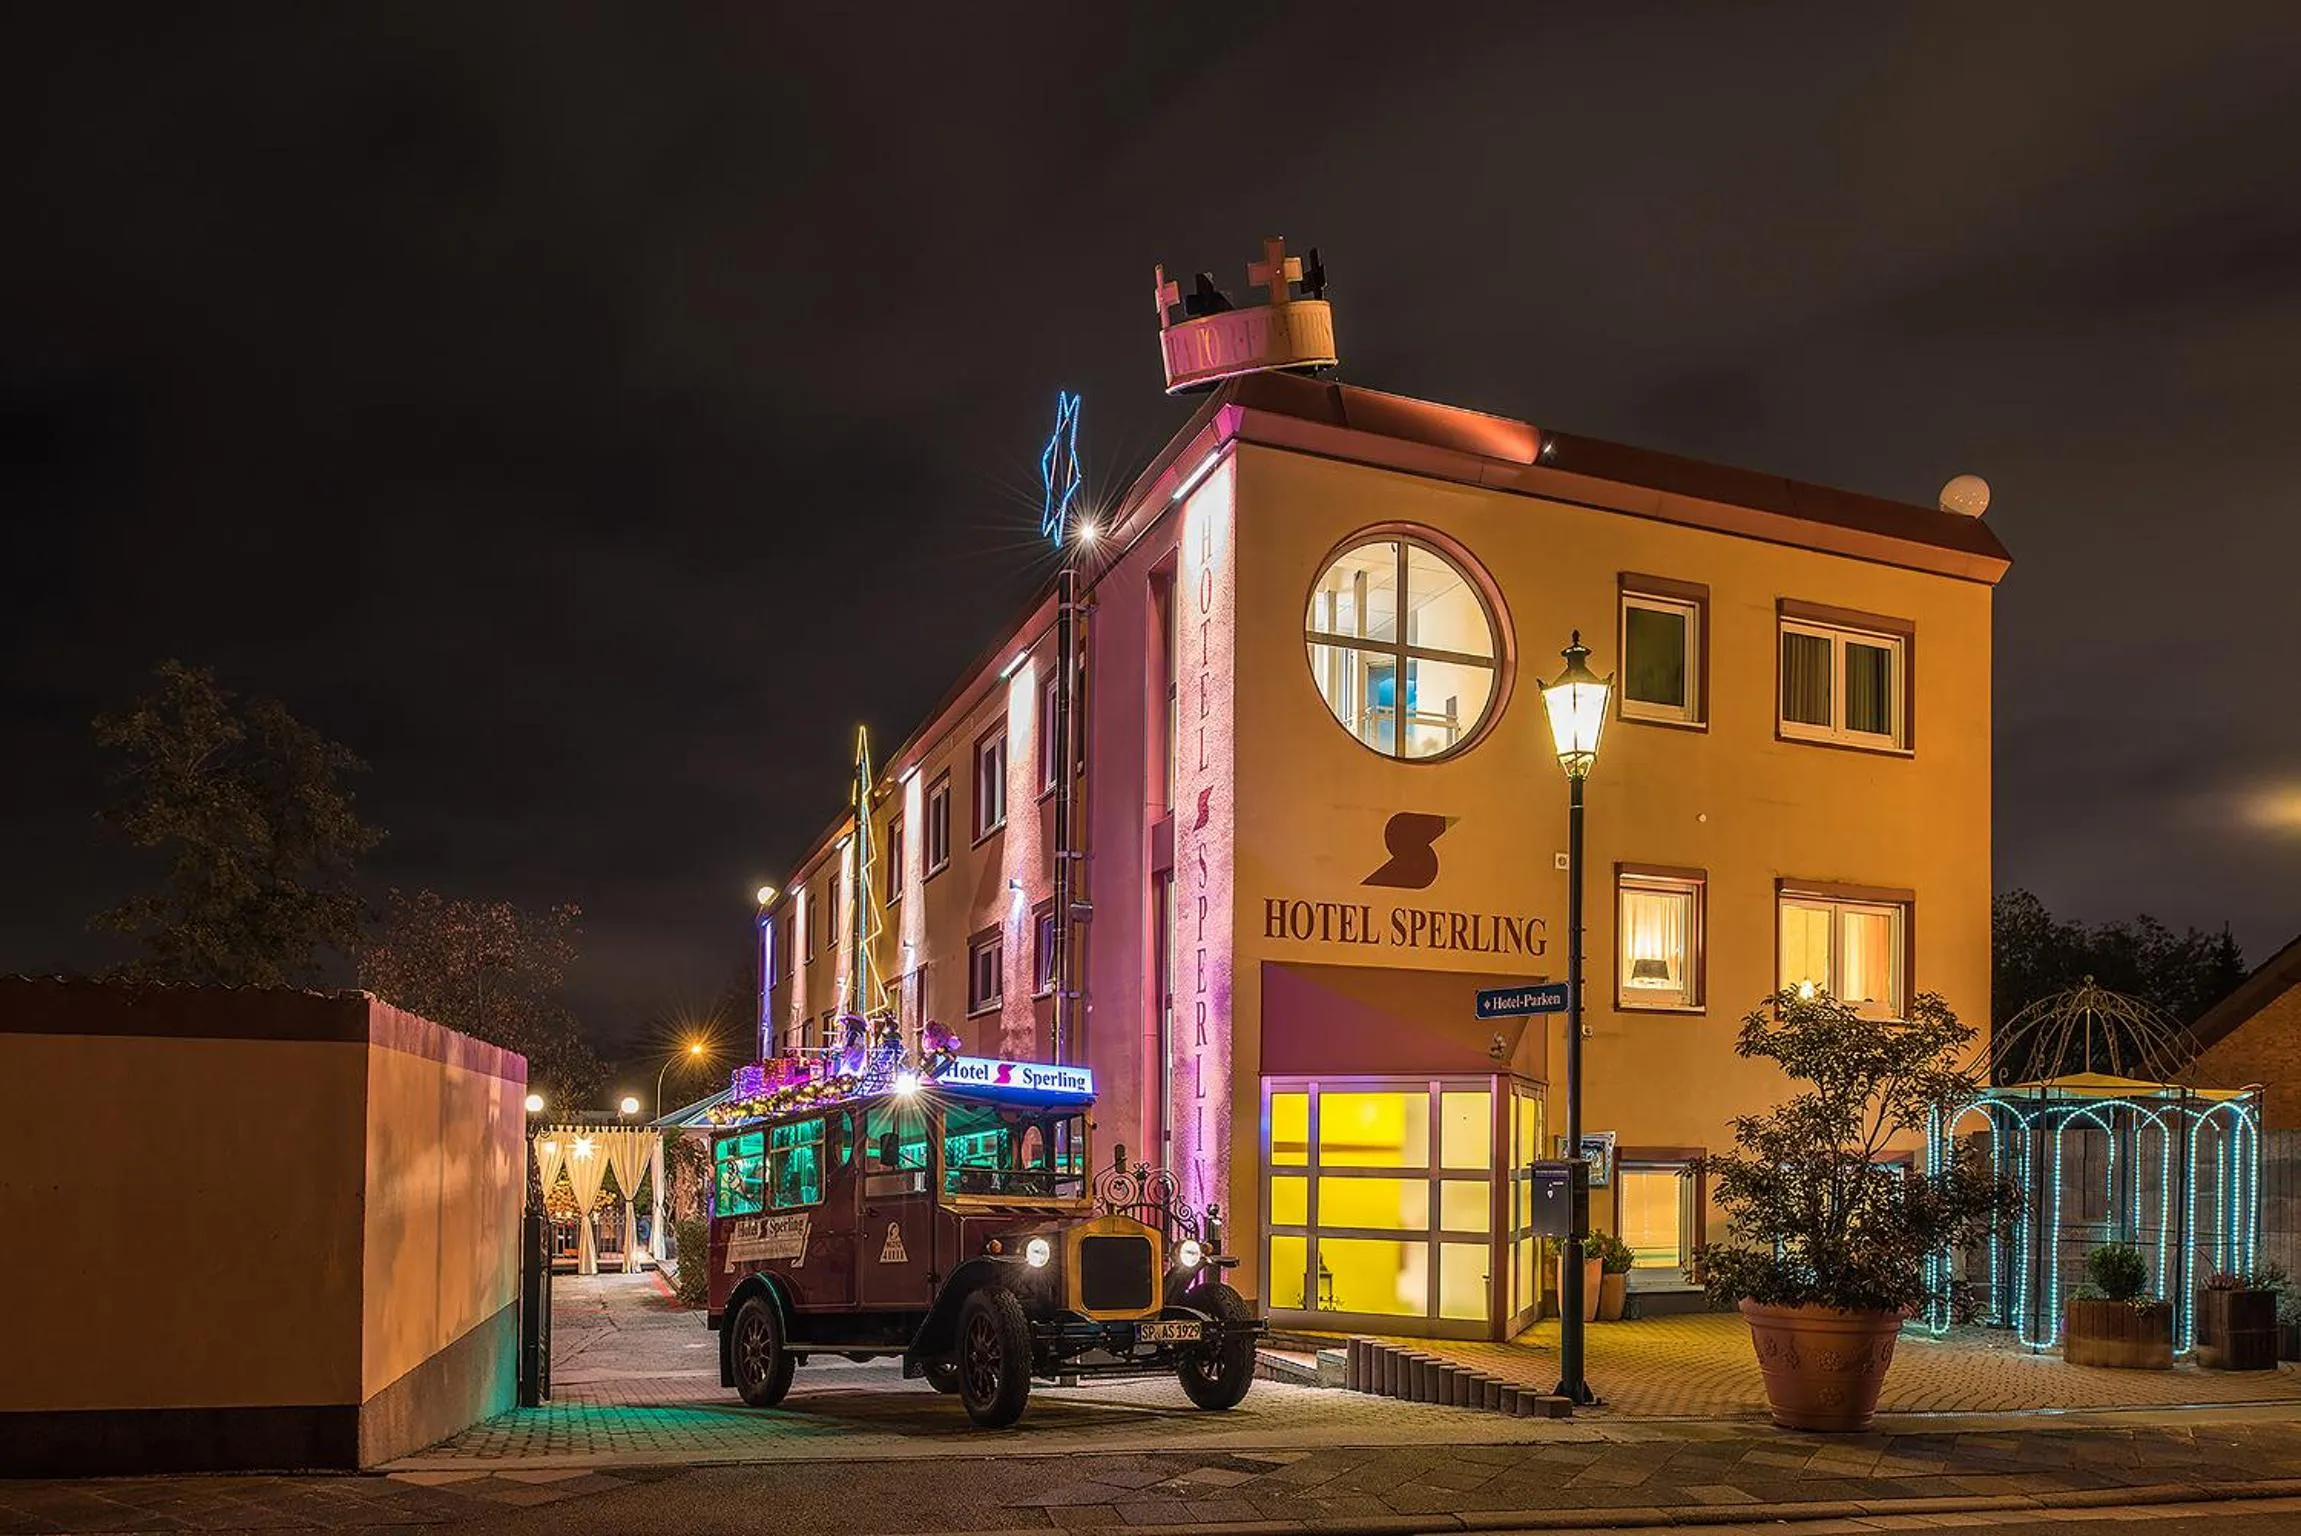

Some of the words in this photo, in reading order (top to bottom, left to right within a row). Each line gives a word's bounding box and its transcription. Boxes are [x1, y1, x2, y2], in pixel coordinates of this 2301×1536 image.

[1199, 513, 1212, 772] HOTEL
[1264, 897, 1379, 945] HOTEL
[1391, 906, 1547, 956] SPERLING
[1493, 992, 1561, 1010] Hotel-Parken
[1194, 843, 1209, 1225] SPERLIN
[947, 1061, 989, 1081] Hotel
[1022, 1068, 1086, 1091] Sperling
